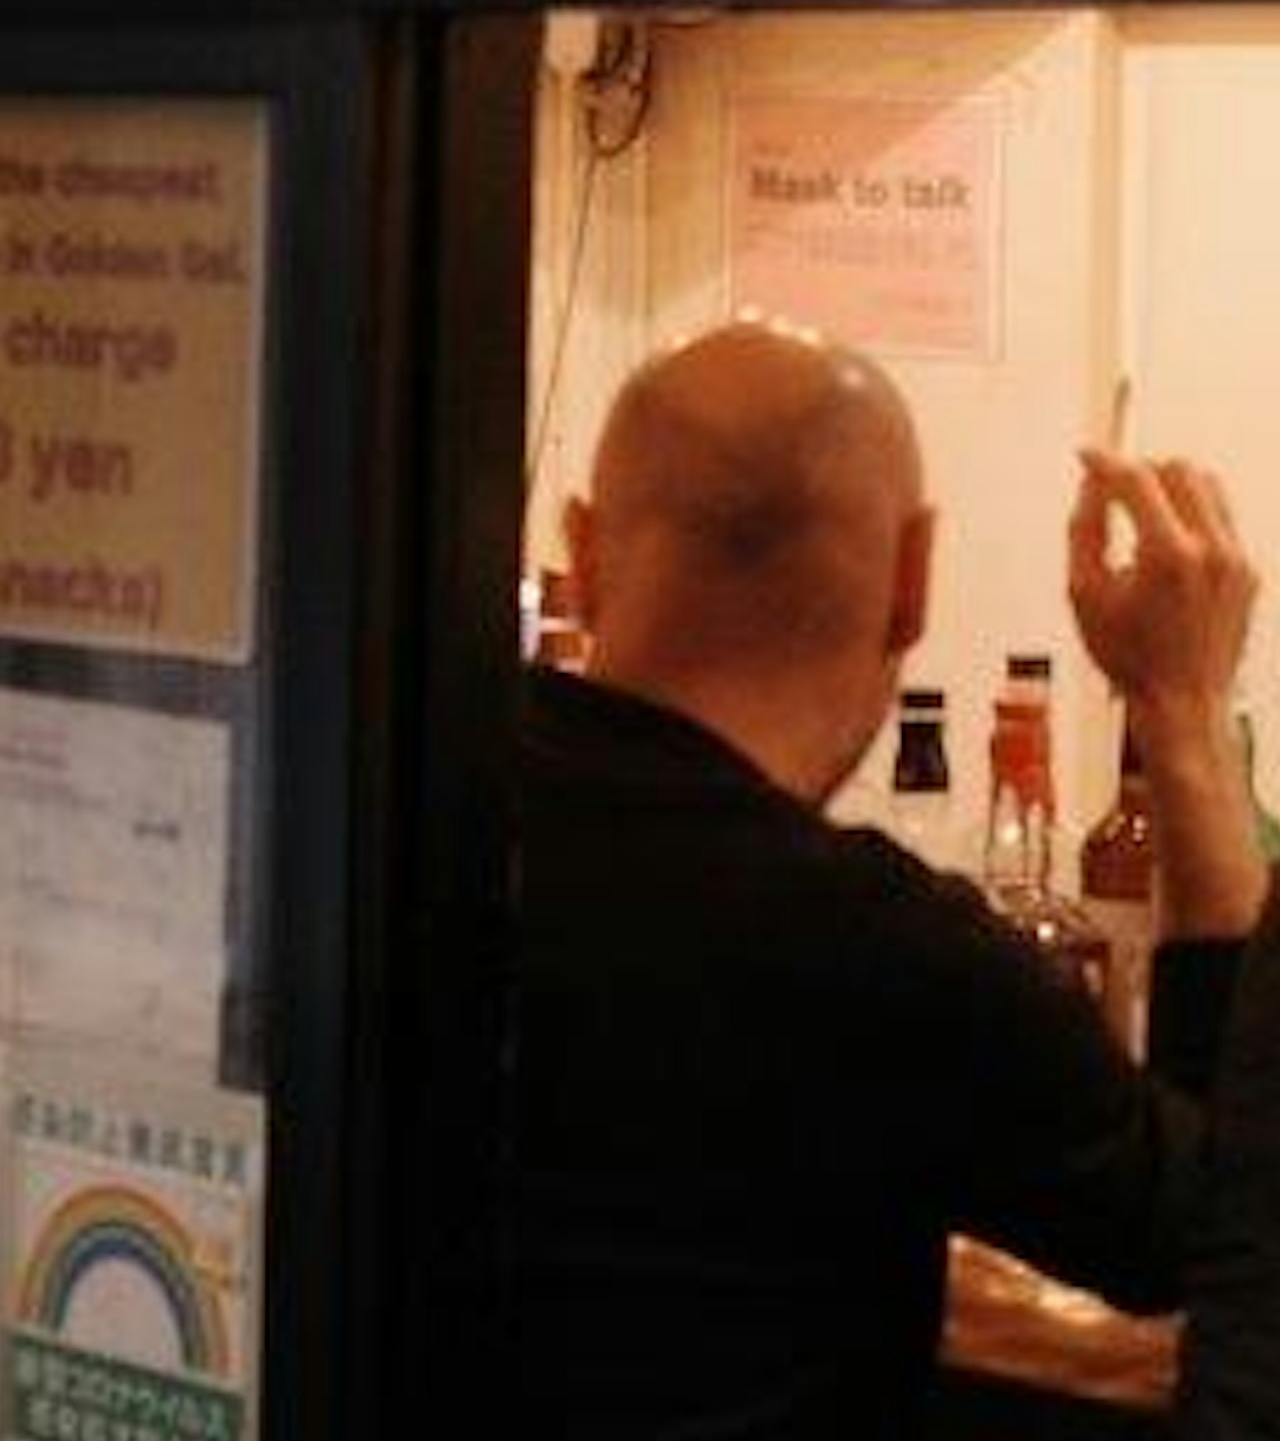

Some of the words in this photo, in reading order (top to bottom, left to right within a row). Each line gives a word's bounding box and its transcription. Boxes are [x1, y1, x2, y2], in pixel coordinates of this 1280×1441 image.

[749, 166, 839, 206] Mask
[852, 174, 890, 209] to
[902, 174, 970, 211] talk
[6, 232, 34, 272] in
[44, 231, 169, 279] Golden
[3, 310, 178, 381] charge
[29, 432, 134, 502] yen
